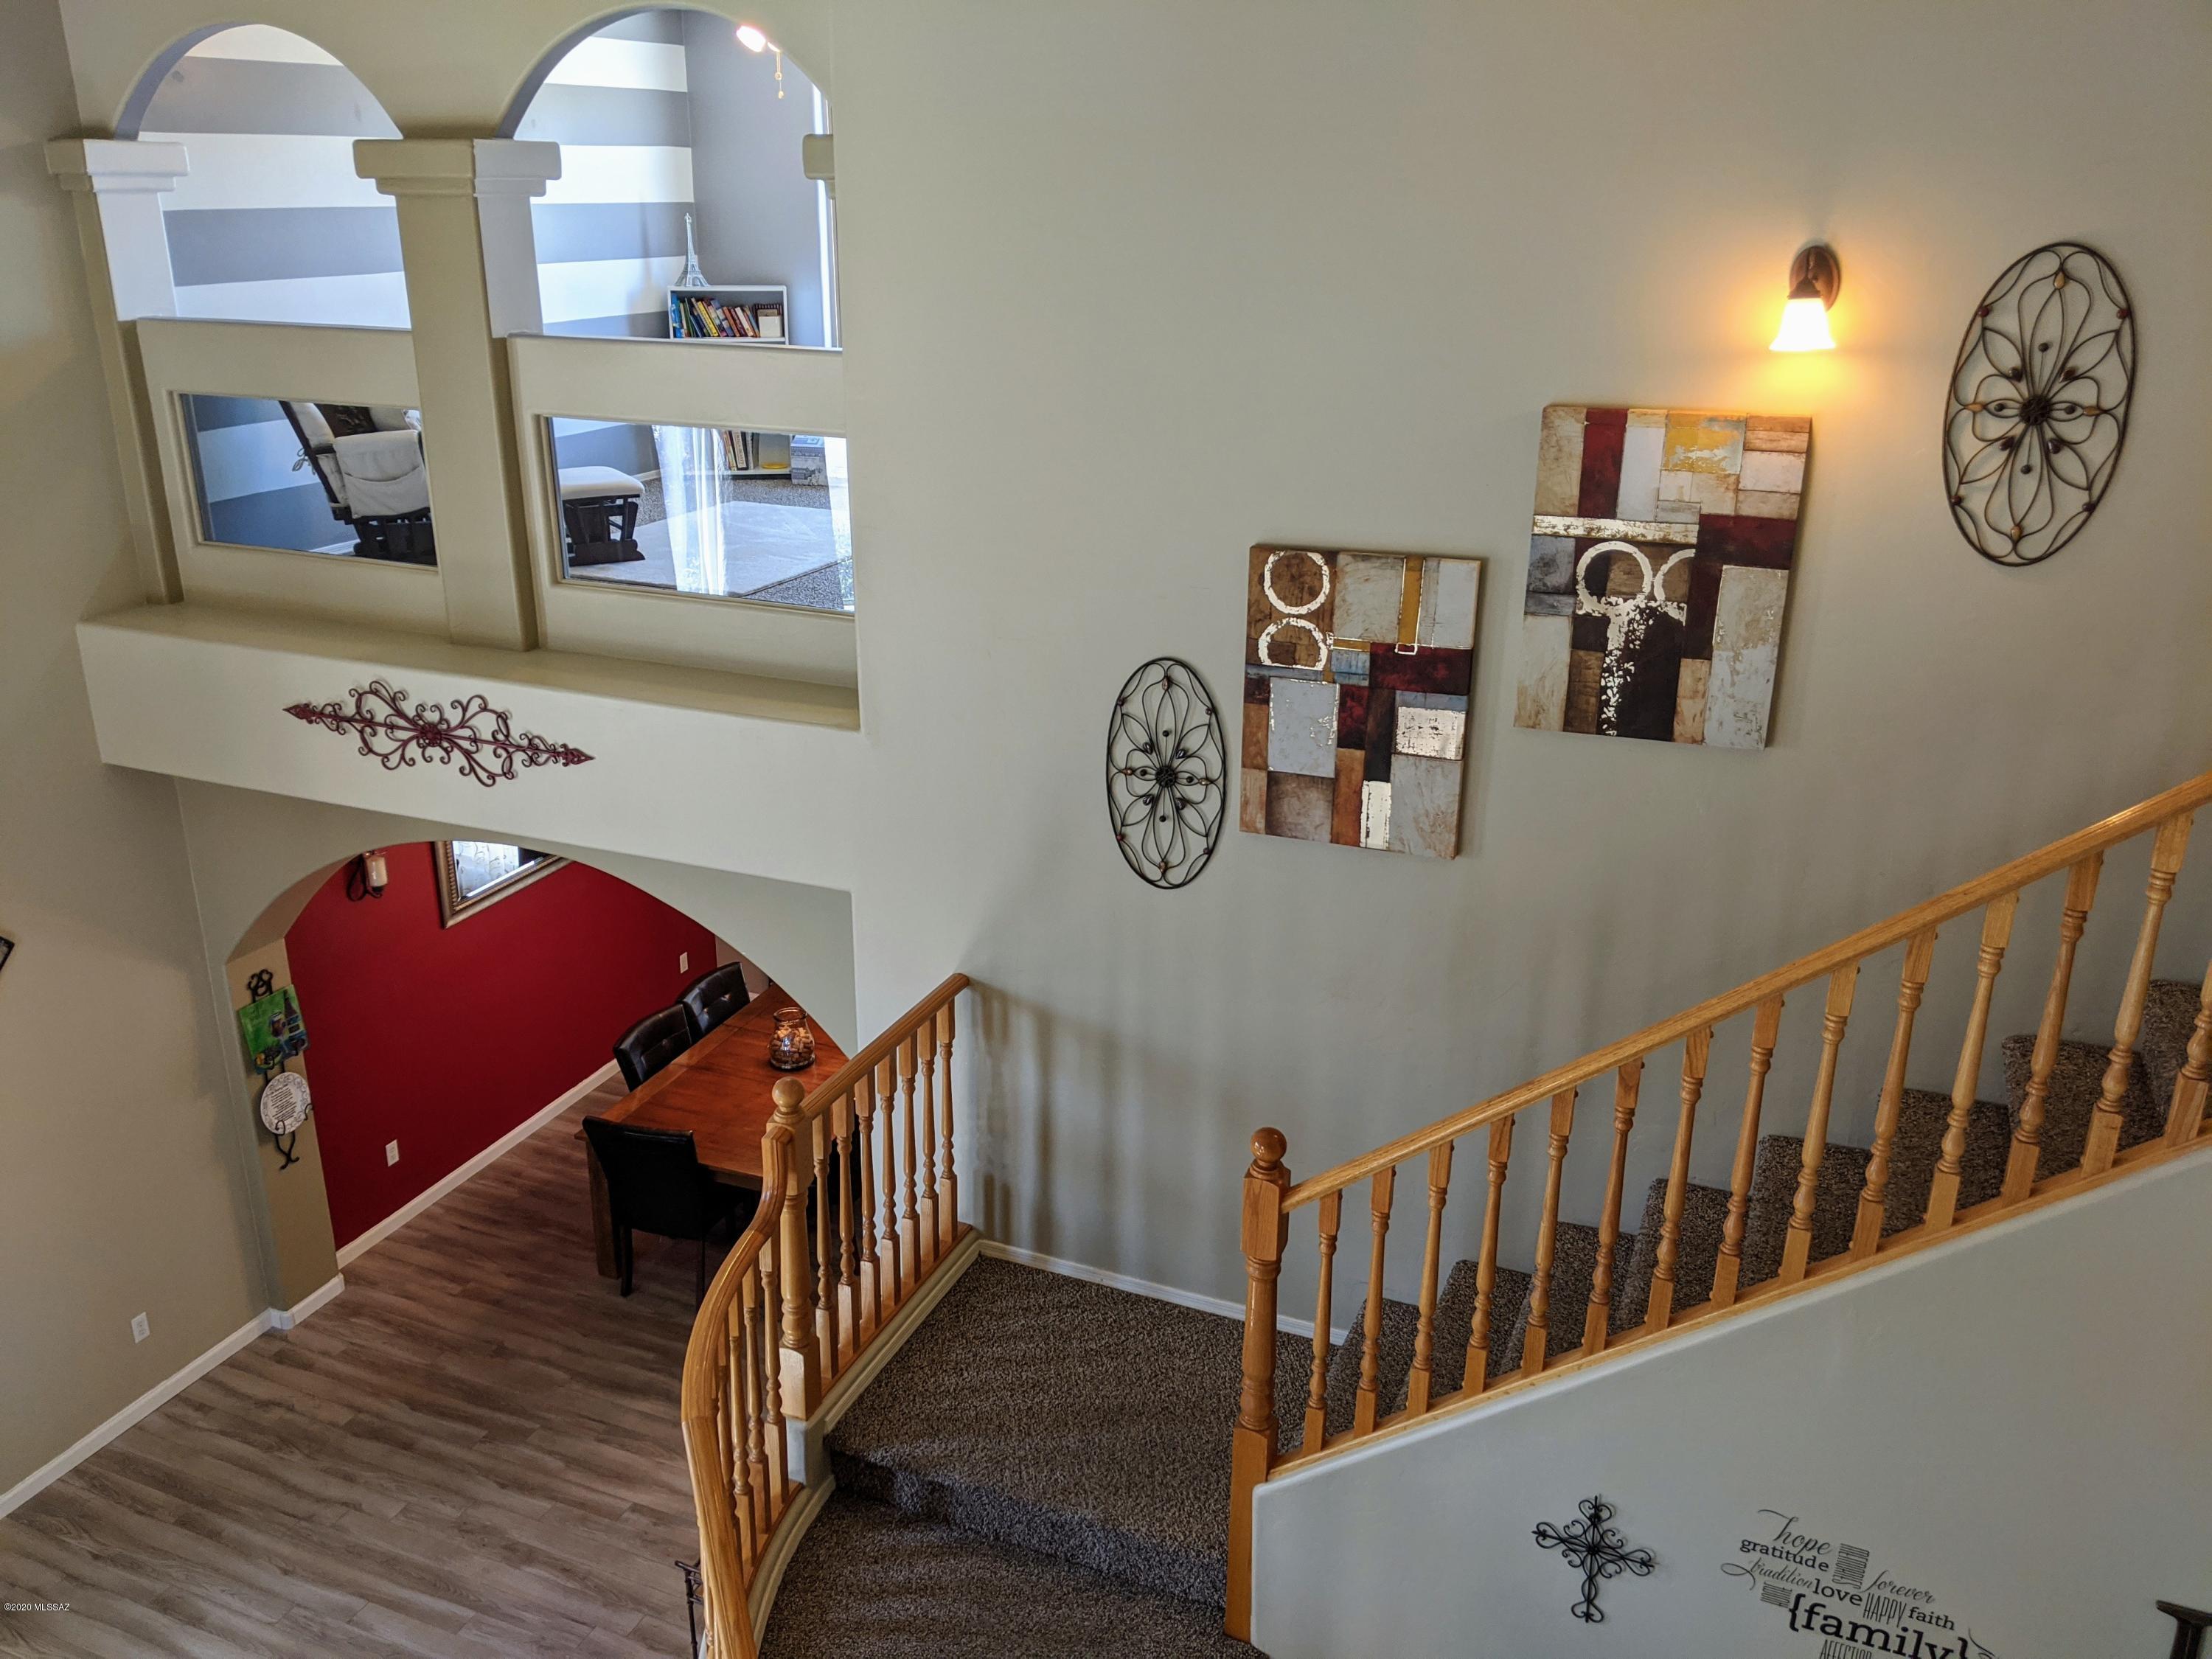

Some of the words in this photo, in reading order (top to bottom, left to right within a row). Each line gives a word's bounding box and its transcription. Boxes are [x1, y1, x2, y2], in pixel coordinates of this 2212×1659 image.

[1758, 1509, 1832, 1555] hope
[1739, 1539, 1829, 1572] gratitude
[1832, 1543, 1870, 1590] MEMORIES
[1721, 1557, 1812, 1590] tradition
[1859, 1569, 1935, 1604] forever
[1760, 1581, 1792, 1609] HOME
[1812, 1578, 1863, 1606] love
[1863, 1592, 1907, 1629] HAPPY
[1907, 1606, 1955, 1631] faith
